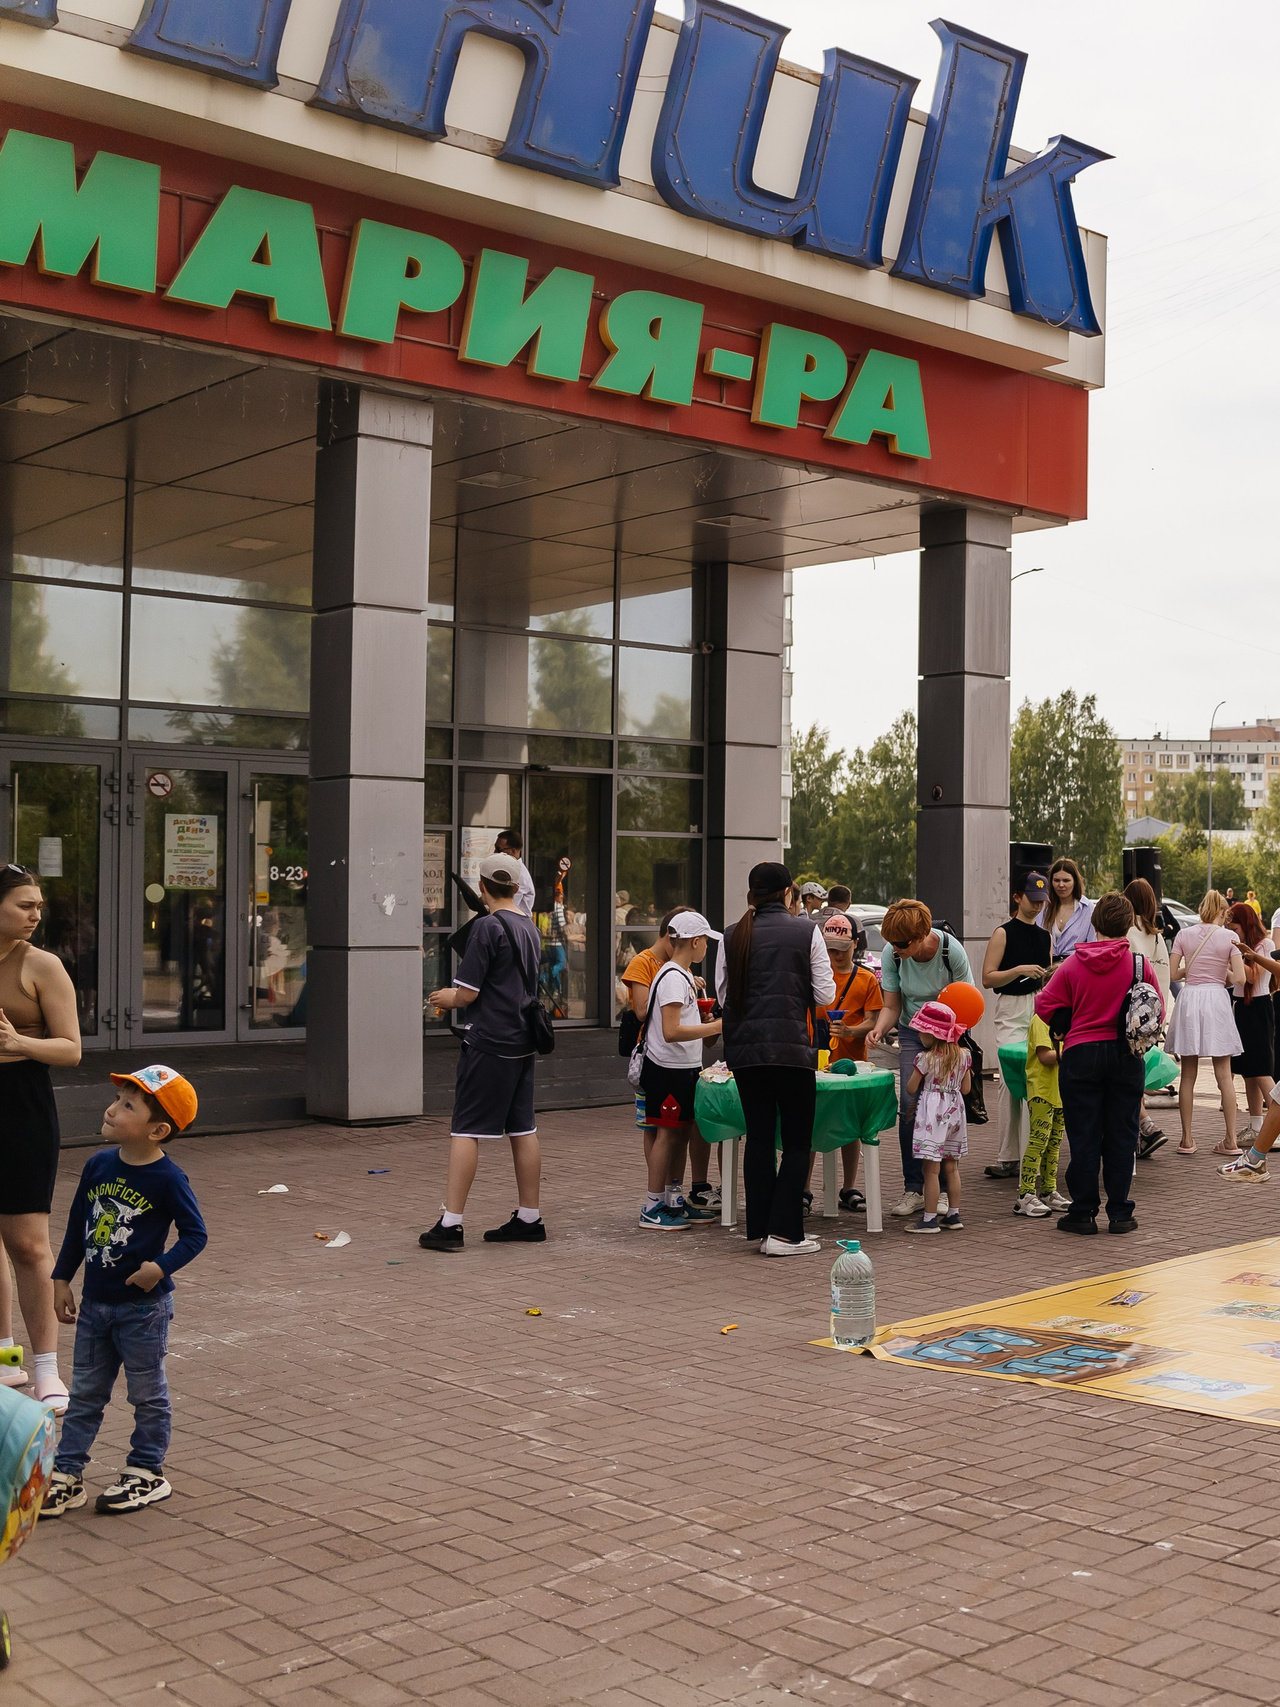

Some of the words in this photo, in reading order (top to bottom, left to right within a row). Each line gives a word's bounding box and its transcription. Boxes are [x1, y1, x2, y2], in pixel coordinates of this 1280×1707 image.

[0, 128, 932, 460] МАРИЯ-РА
[176, 825, 204, 834] ДЕНЬ
[270, 866, 303, 881] 8-23
[825, 926, 848, 936] NINJA
[87, 1183, 153, 1214] MAGNIFICENT
